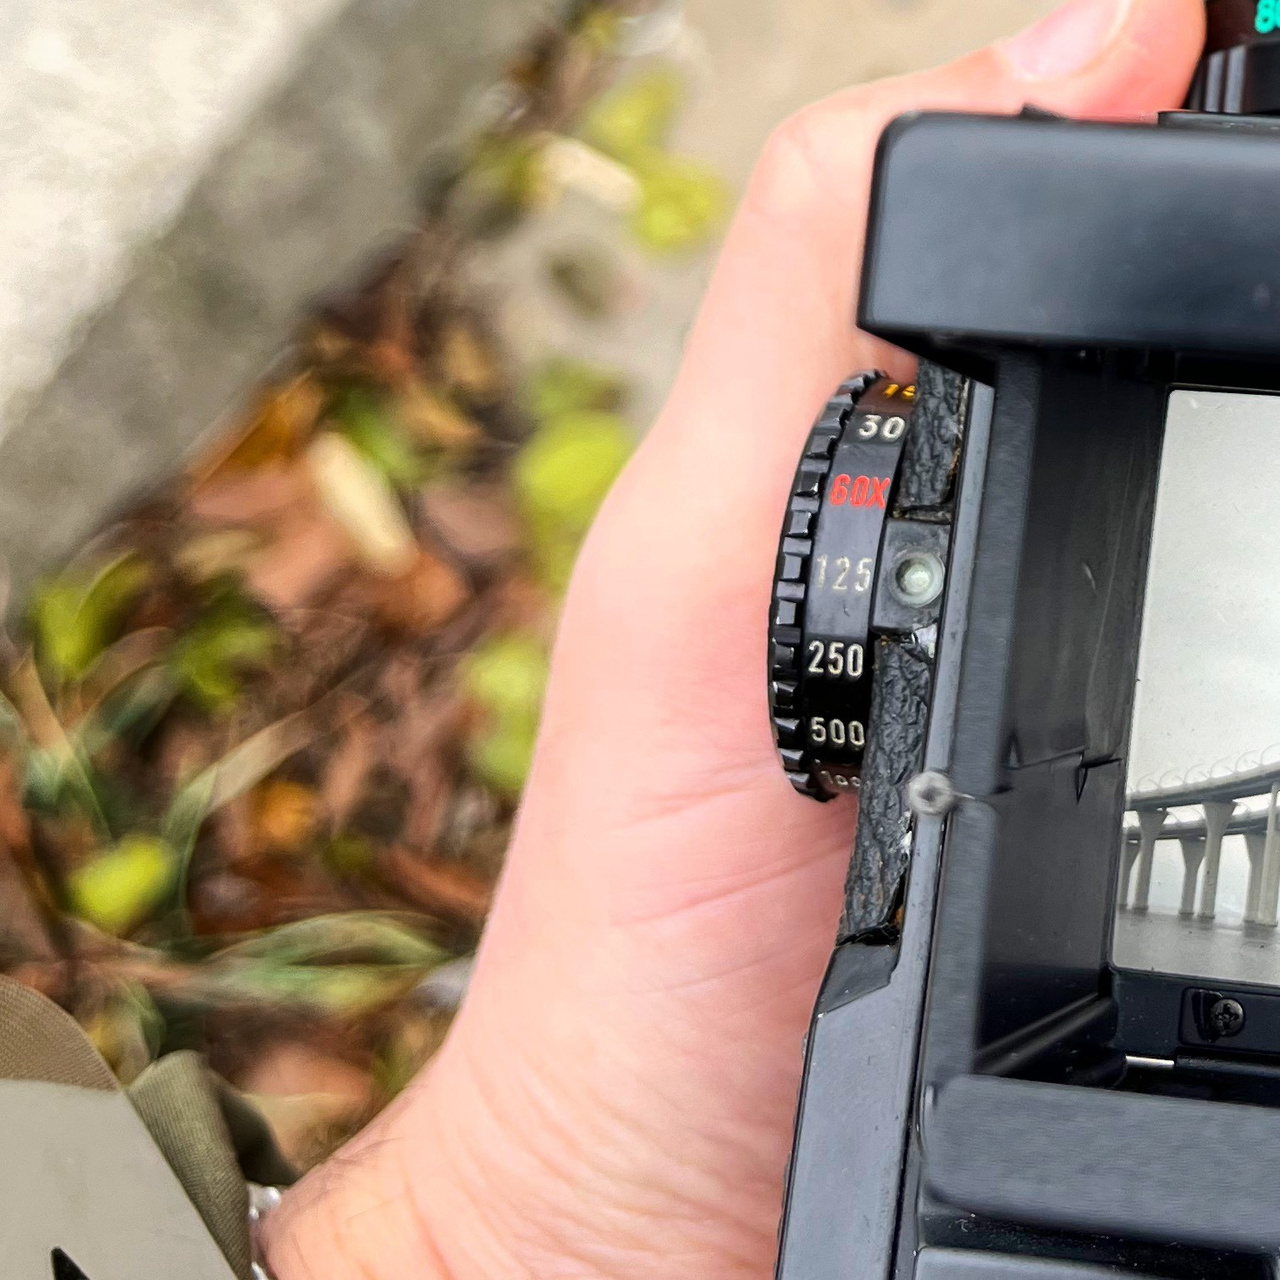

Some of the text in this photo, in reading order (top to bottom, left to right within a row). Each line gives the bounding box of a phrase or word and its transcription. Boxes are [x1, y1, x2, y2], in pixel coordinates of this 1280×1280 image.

[858, 414, 906, 439] 30
[829, 473, 891, 508] 60X
[816, 554, 873, 592] 125
[808, 640, 865, 678] 250
[811, 716, 865, 746] 500
